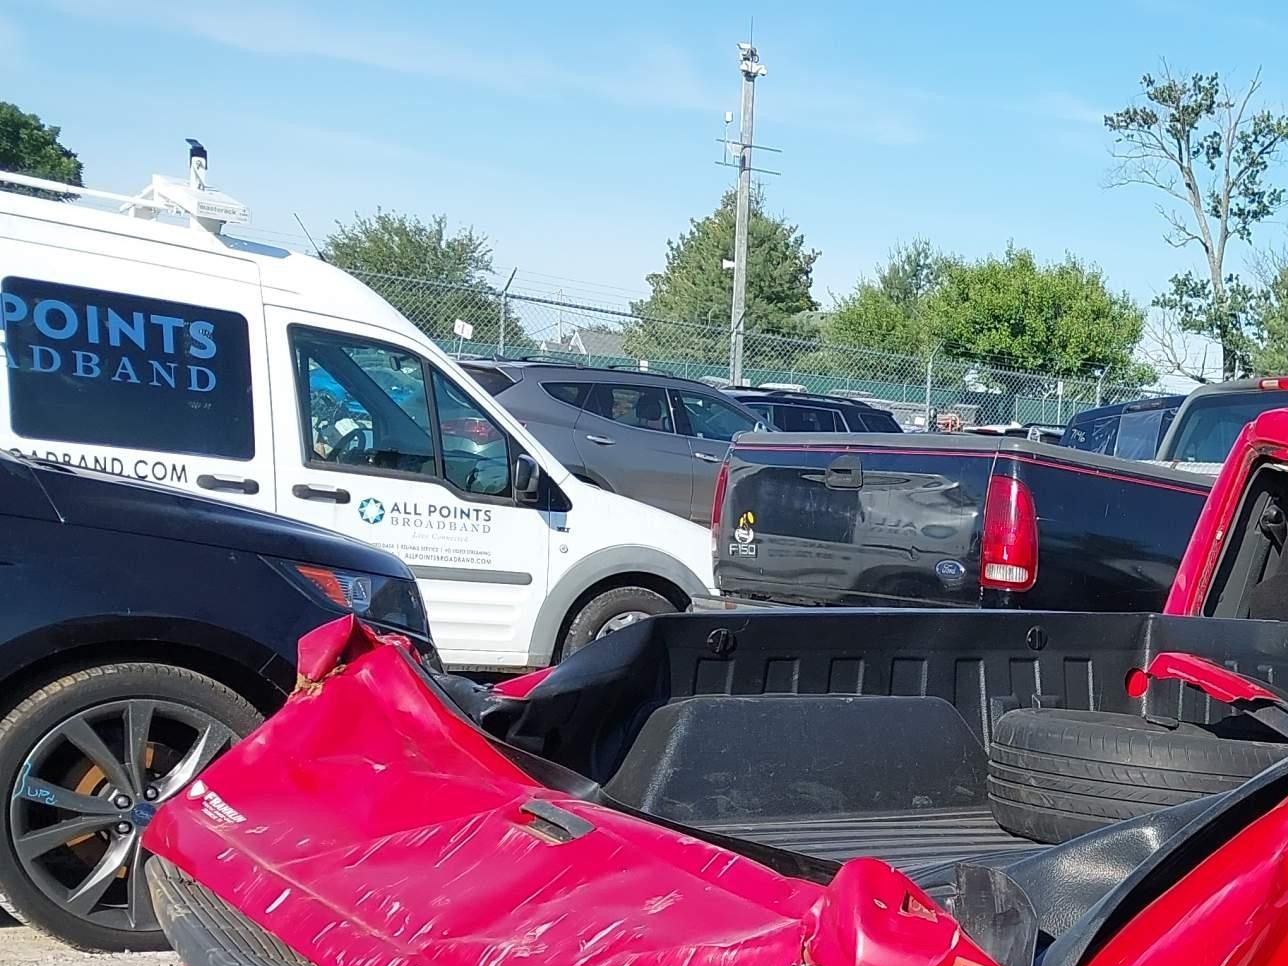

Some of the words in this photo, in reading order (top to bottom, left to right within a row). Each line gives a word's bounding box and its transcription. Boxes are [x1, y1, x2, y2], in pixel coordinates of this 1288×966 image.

[0, 293, 217, 359] POINTS
[390, 502, 422, 516] ALL
[428, 504, 492, 522] POINTS
[391, 516, 491, 534] BROADBAND
